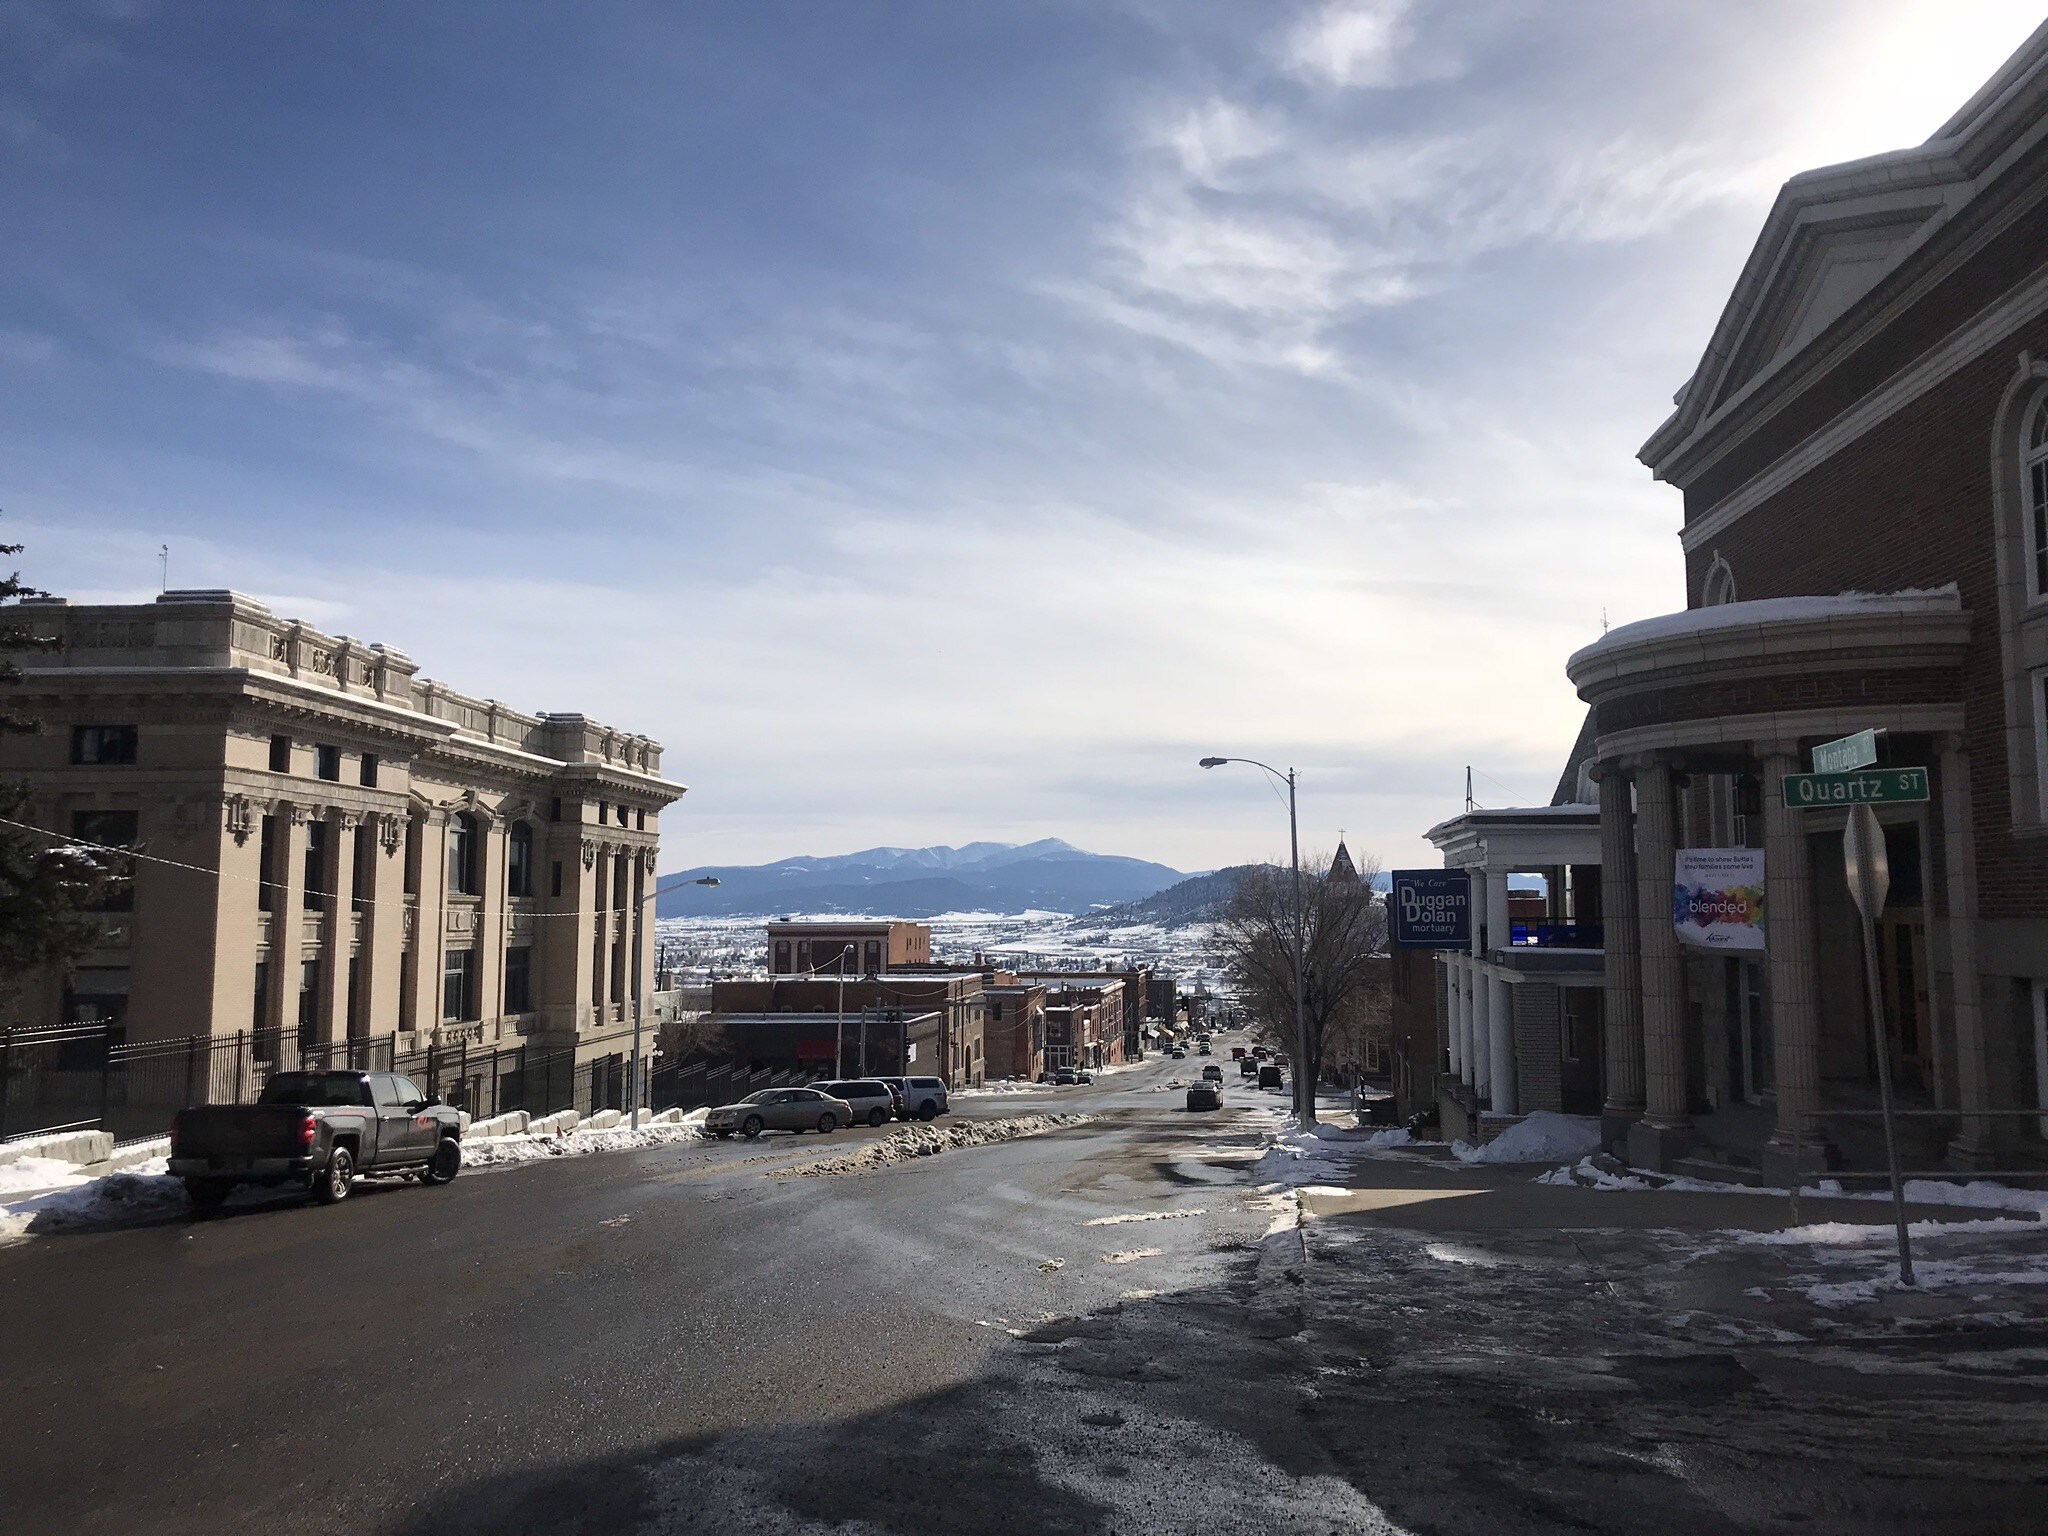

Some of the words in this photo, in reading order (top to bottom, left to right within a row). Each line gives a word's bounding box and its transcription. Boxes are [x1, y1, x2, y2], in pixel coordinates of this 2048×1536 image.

[1819, 745, 1858, 772] Montana
[1799, 776, 1884, 802] Quartz
[1898, 773, 1919, 790] ST
[1401, 886, 1466, 910] Duggan
[1689, 899, 1747, 913] blended
[1406, 903, 1457, 922] Dolan
[1412, 924, 1455, 935] mortuary
